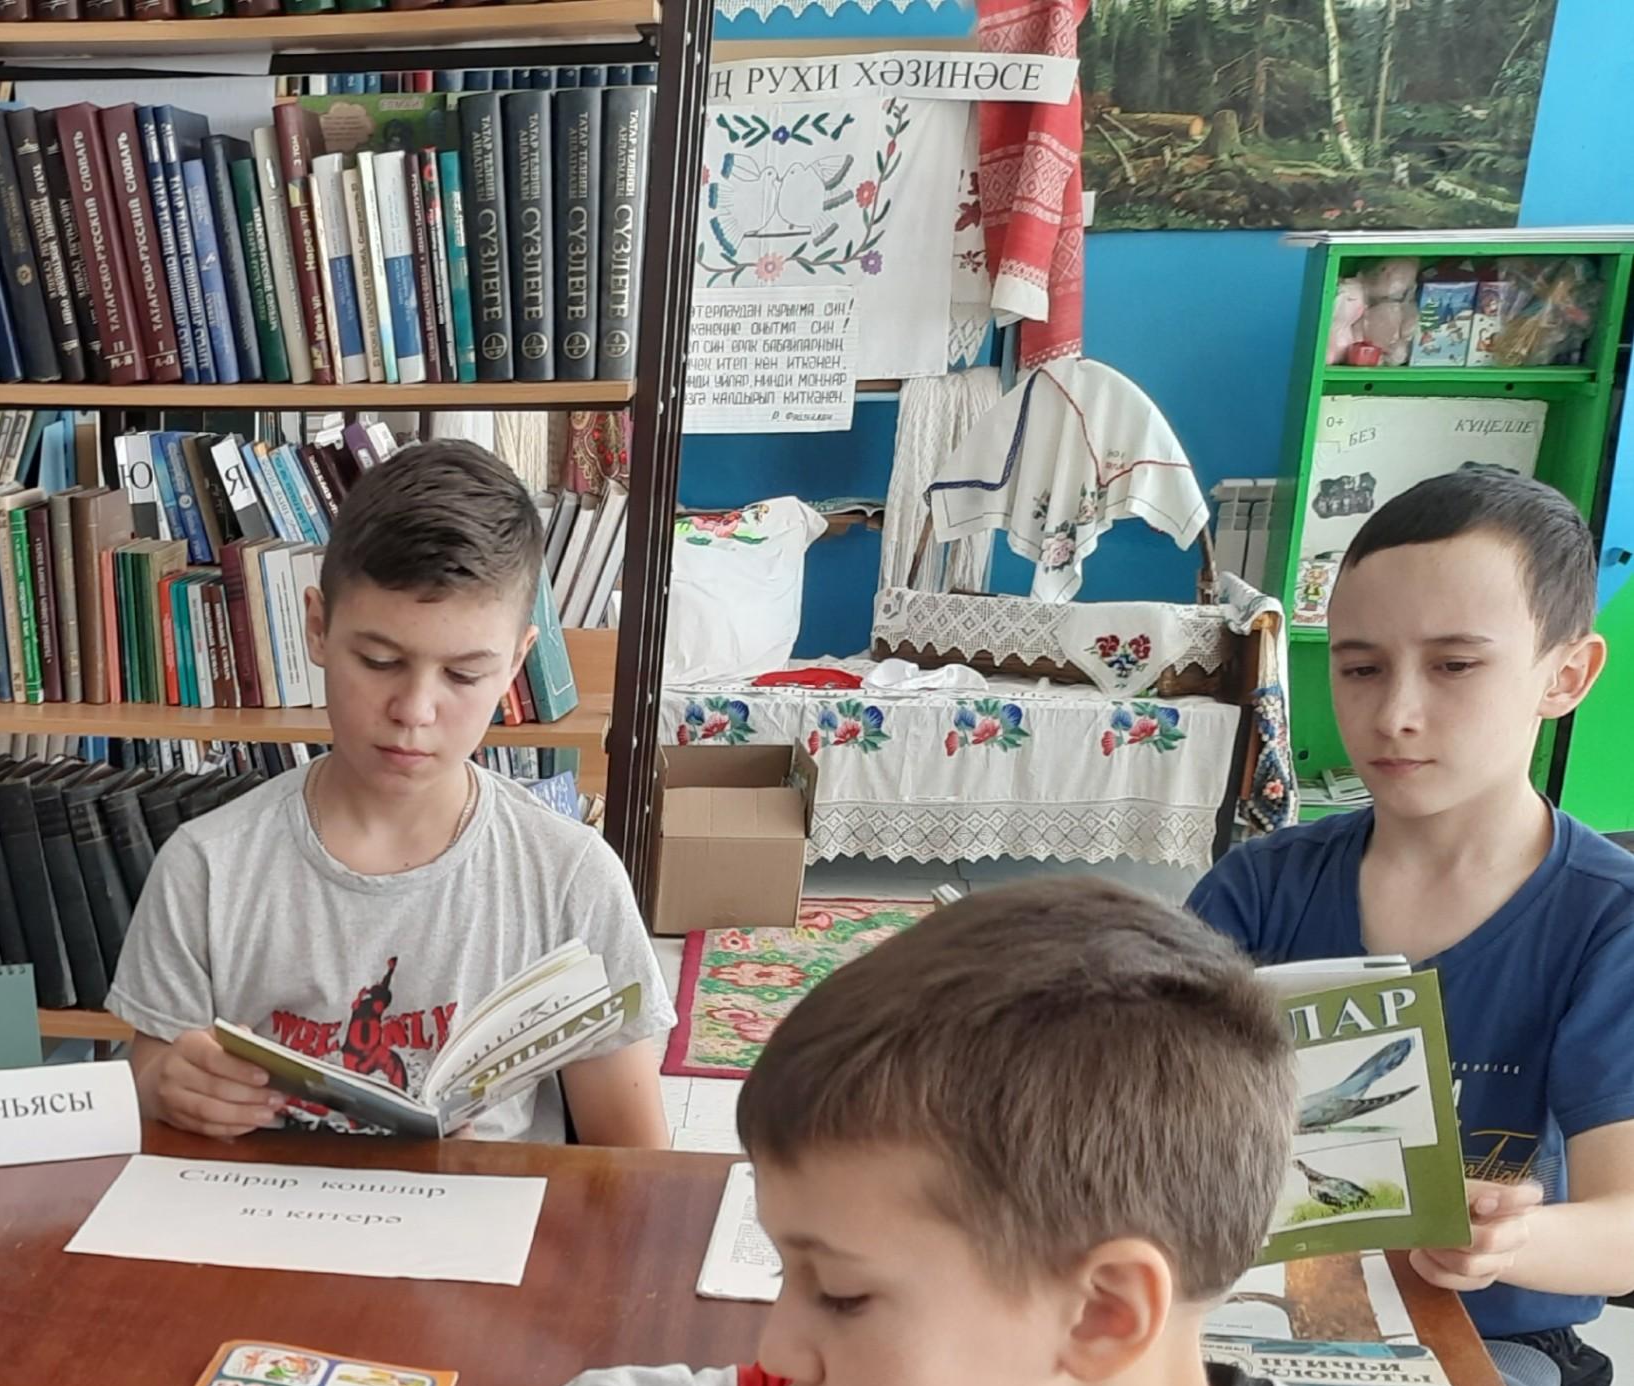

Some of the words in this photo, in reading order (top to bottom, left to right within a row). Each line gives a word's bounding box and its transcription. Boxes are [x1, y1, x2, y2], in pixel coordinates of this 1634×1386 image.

[747, 64, 841, 94] РУХИ
[852, 59, 1044, 93] ХӘЗИНӘСЕ
[479, 115, 491, 158] ТАТАР
[528, 112, 538, 154] ТАТАР
[580, 111, 589, 153] ТАТАР
[630, 109, 639, 151] ТАТАР
[72, 129, 93, 192] СЛОВАРЬ
[116, 130, 138, 192] СЛОВАРЬ
[87, 198, 119, 332] ТАТАРСКО-РУССКИЙ
[127, 198, 165, 332] ТАТАРСКО-РУССКИЙ
[1348, 427, 1377, 447] БЕЗ
[224, 468, 249, 499] Я
[1288, 986, 1417, 1044] ЛАР
[178, 1167, 300, 1191] Сайрар
[320, 1178, 447, 1199] кошлар
[1260, 1357, 1406, 1372] ПТИЧЬИ
[1260, 1367, 1435, 1384] ХЛОПОТЫ
